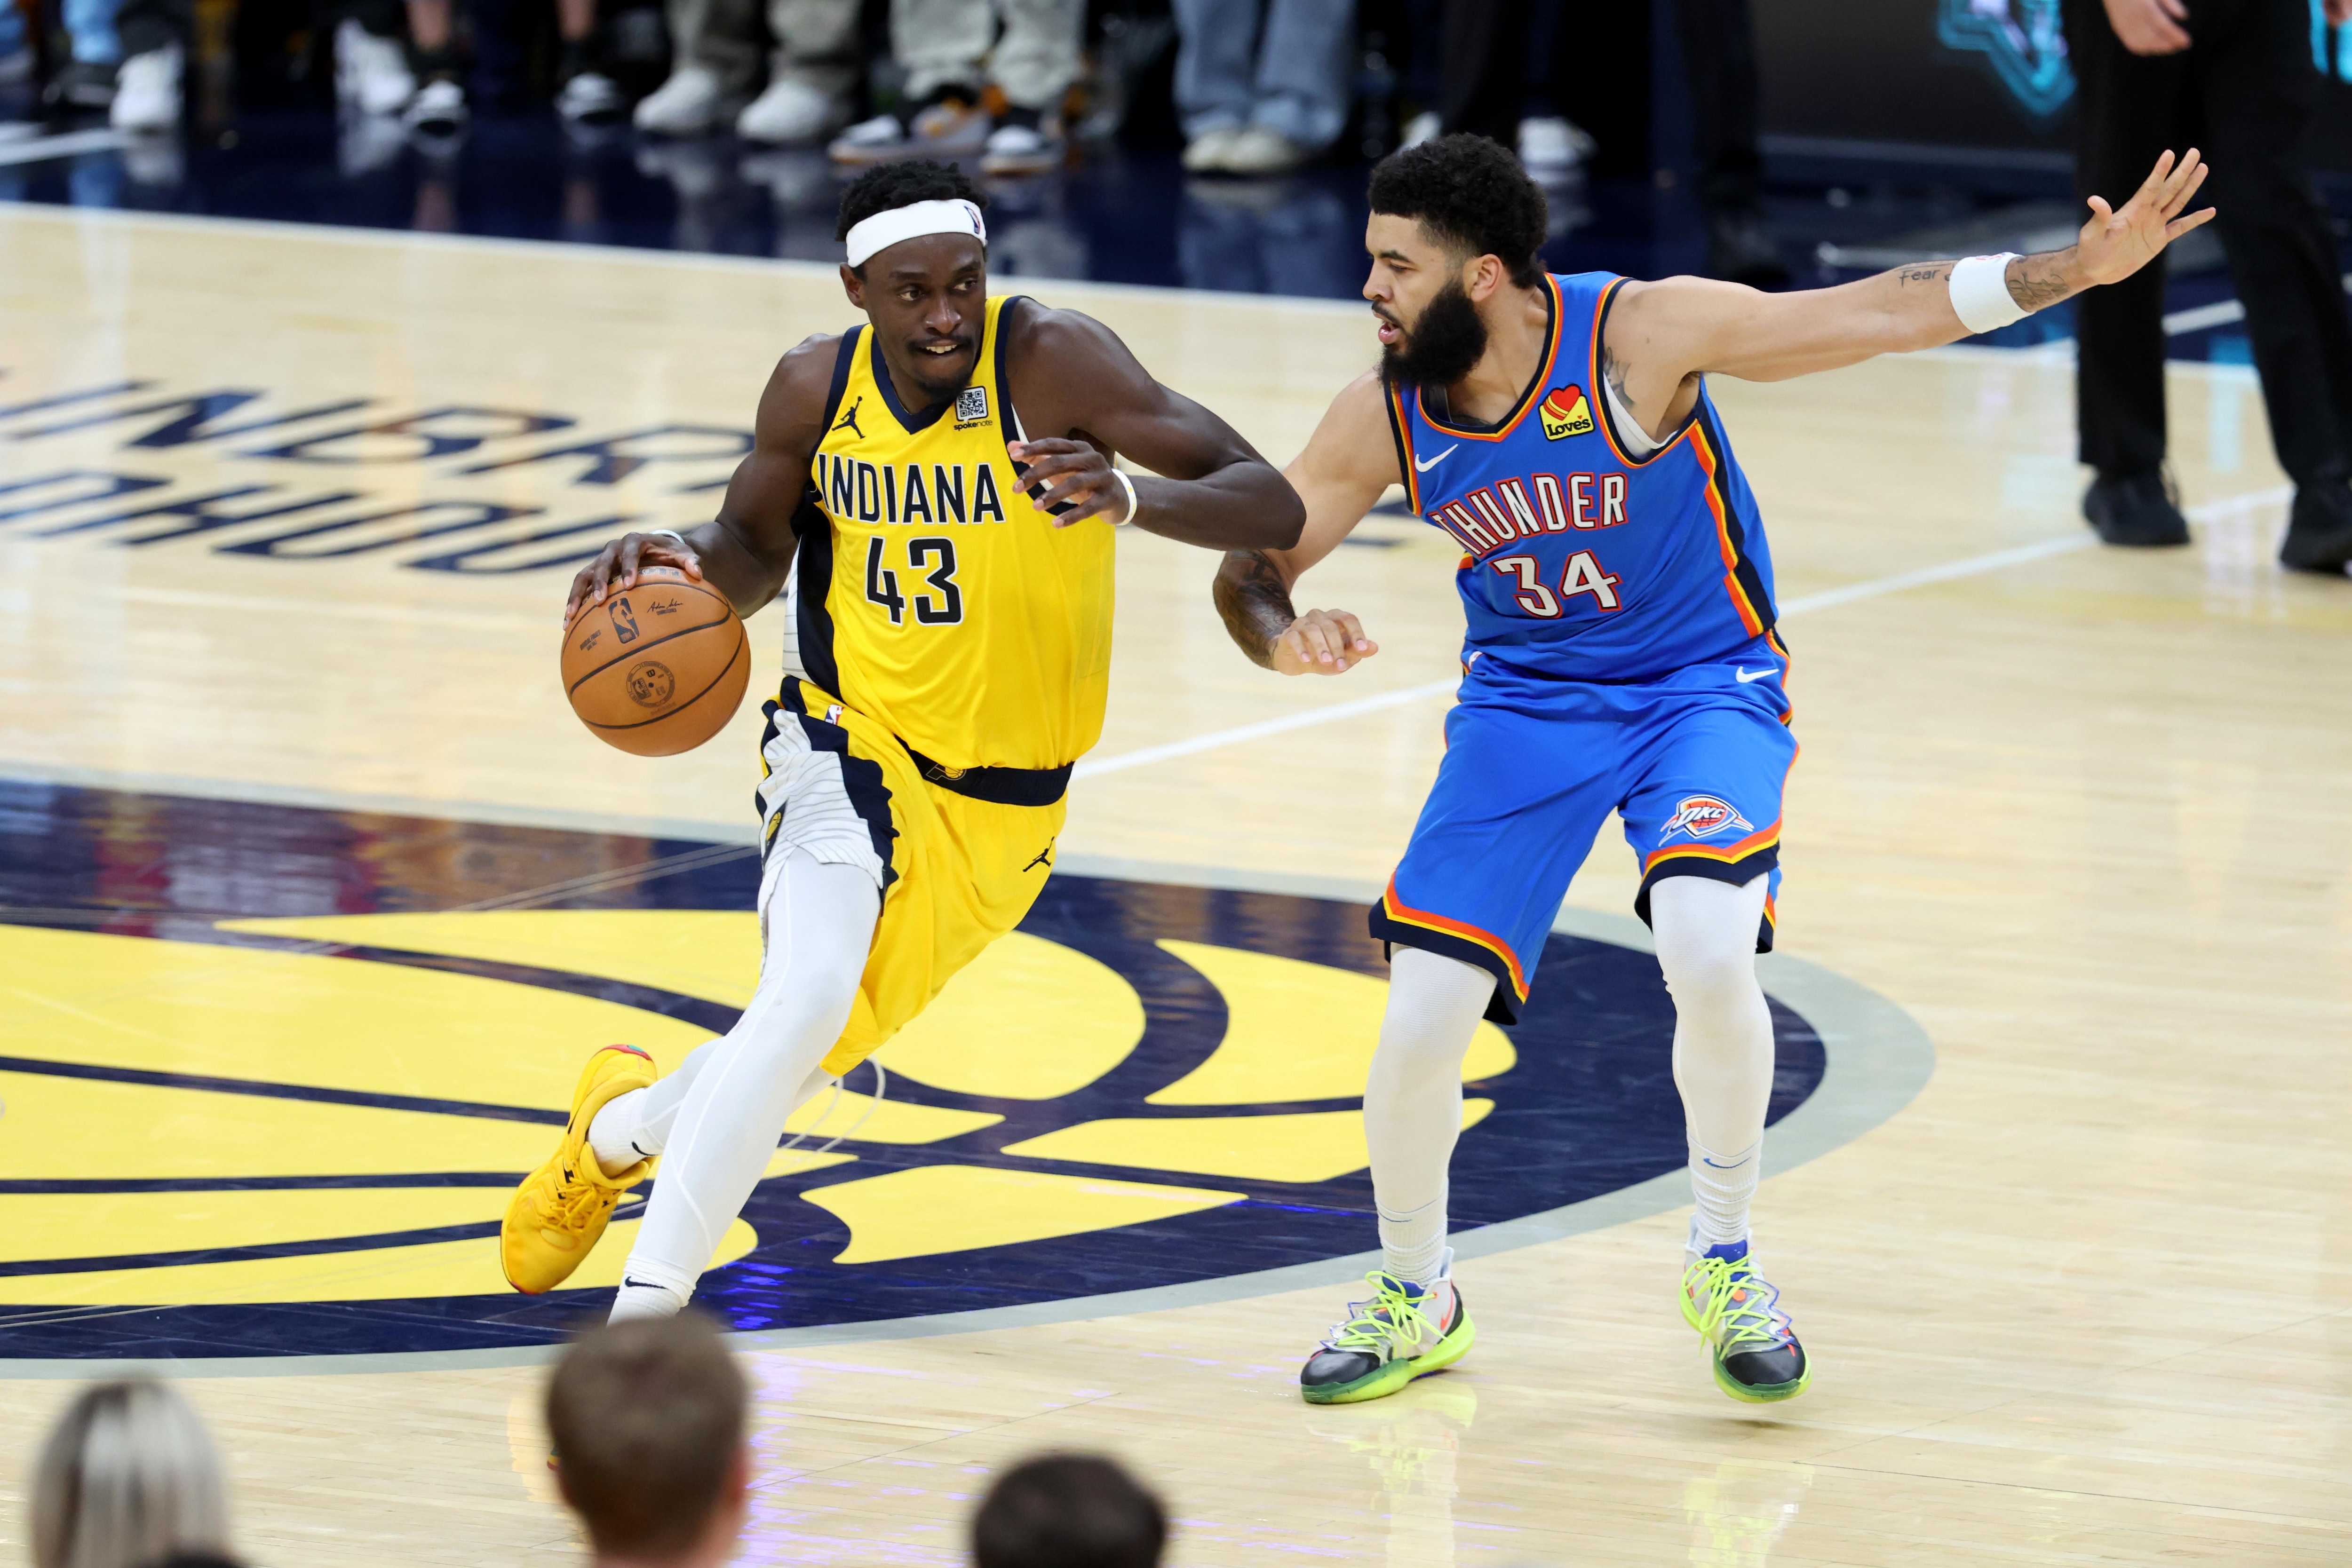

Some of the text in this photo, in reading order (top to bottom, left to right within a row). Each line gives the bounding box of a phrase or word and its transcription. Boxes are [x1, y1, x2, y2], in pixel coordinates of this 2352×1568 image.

[954, 420, 993, 431] spokenote
[817, 452, 1007, 525] INDIANA
[1428, 472, 1629, 559] THUNDER
[865, 535, 964, 626] 43
[1487, 549, 1622, 618] 34
[1671, 806, 1726, 830] OKC
